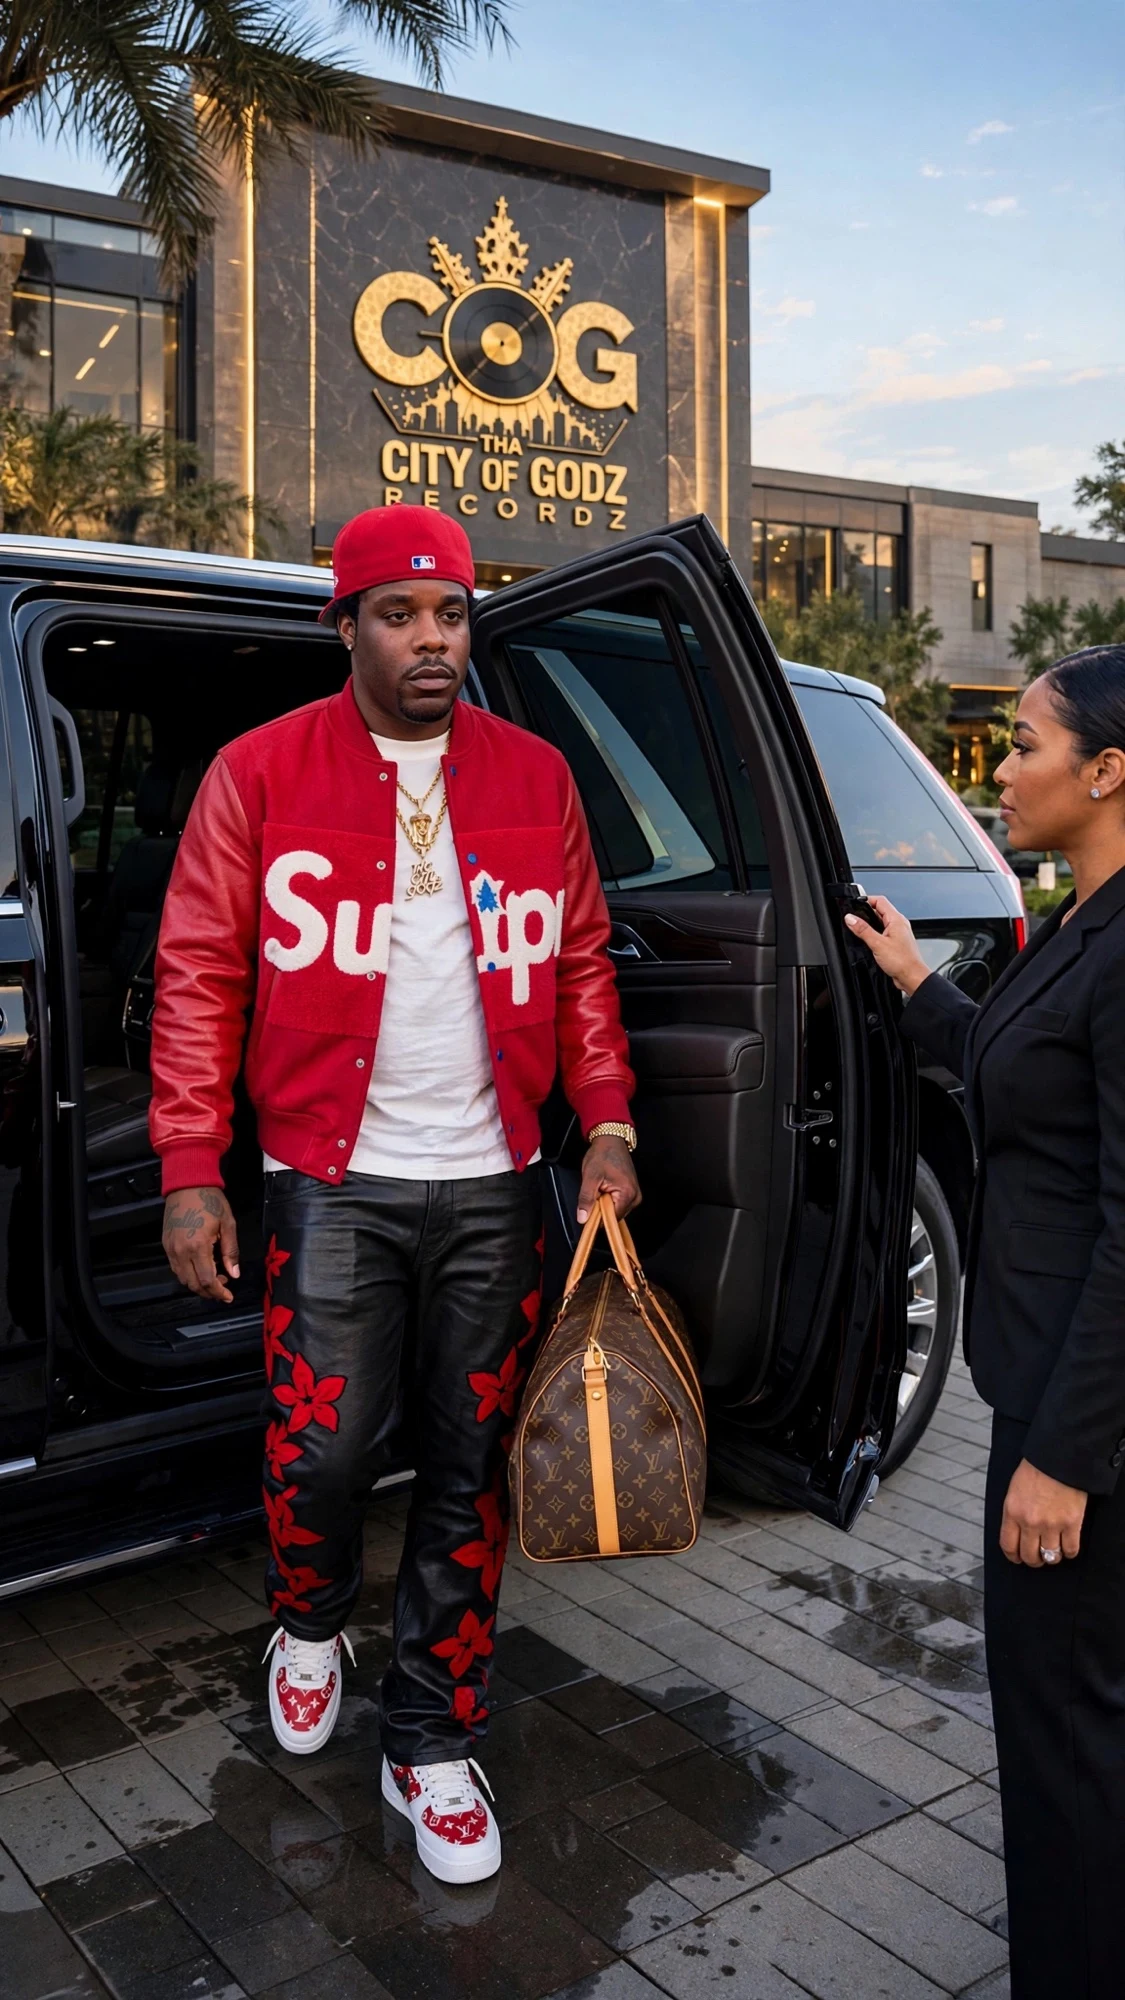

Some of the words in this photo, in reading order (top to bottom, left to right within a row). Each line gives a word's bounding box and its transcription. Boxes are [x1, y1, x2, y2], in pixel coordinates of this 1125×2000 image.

[480, 433, 523, 456] THA
[381, 440, 473, 489] CITY
[482, 458, 519, 492] OF
[530, 456, 628, 505] GODZ
[385, 486, 627, 530] RECORDZ
